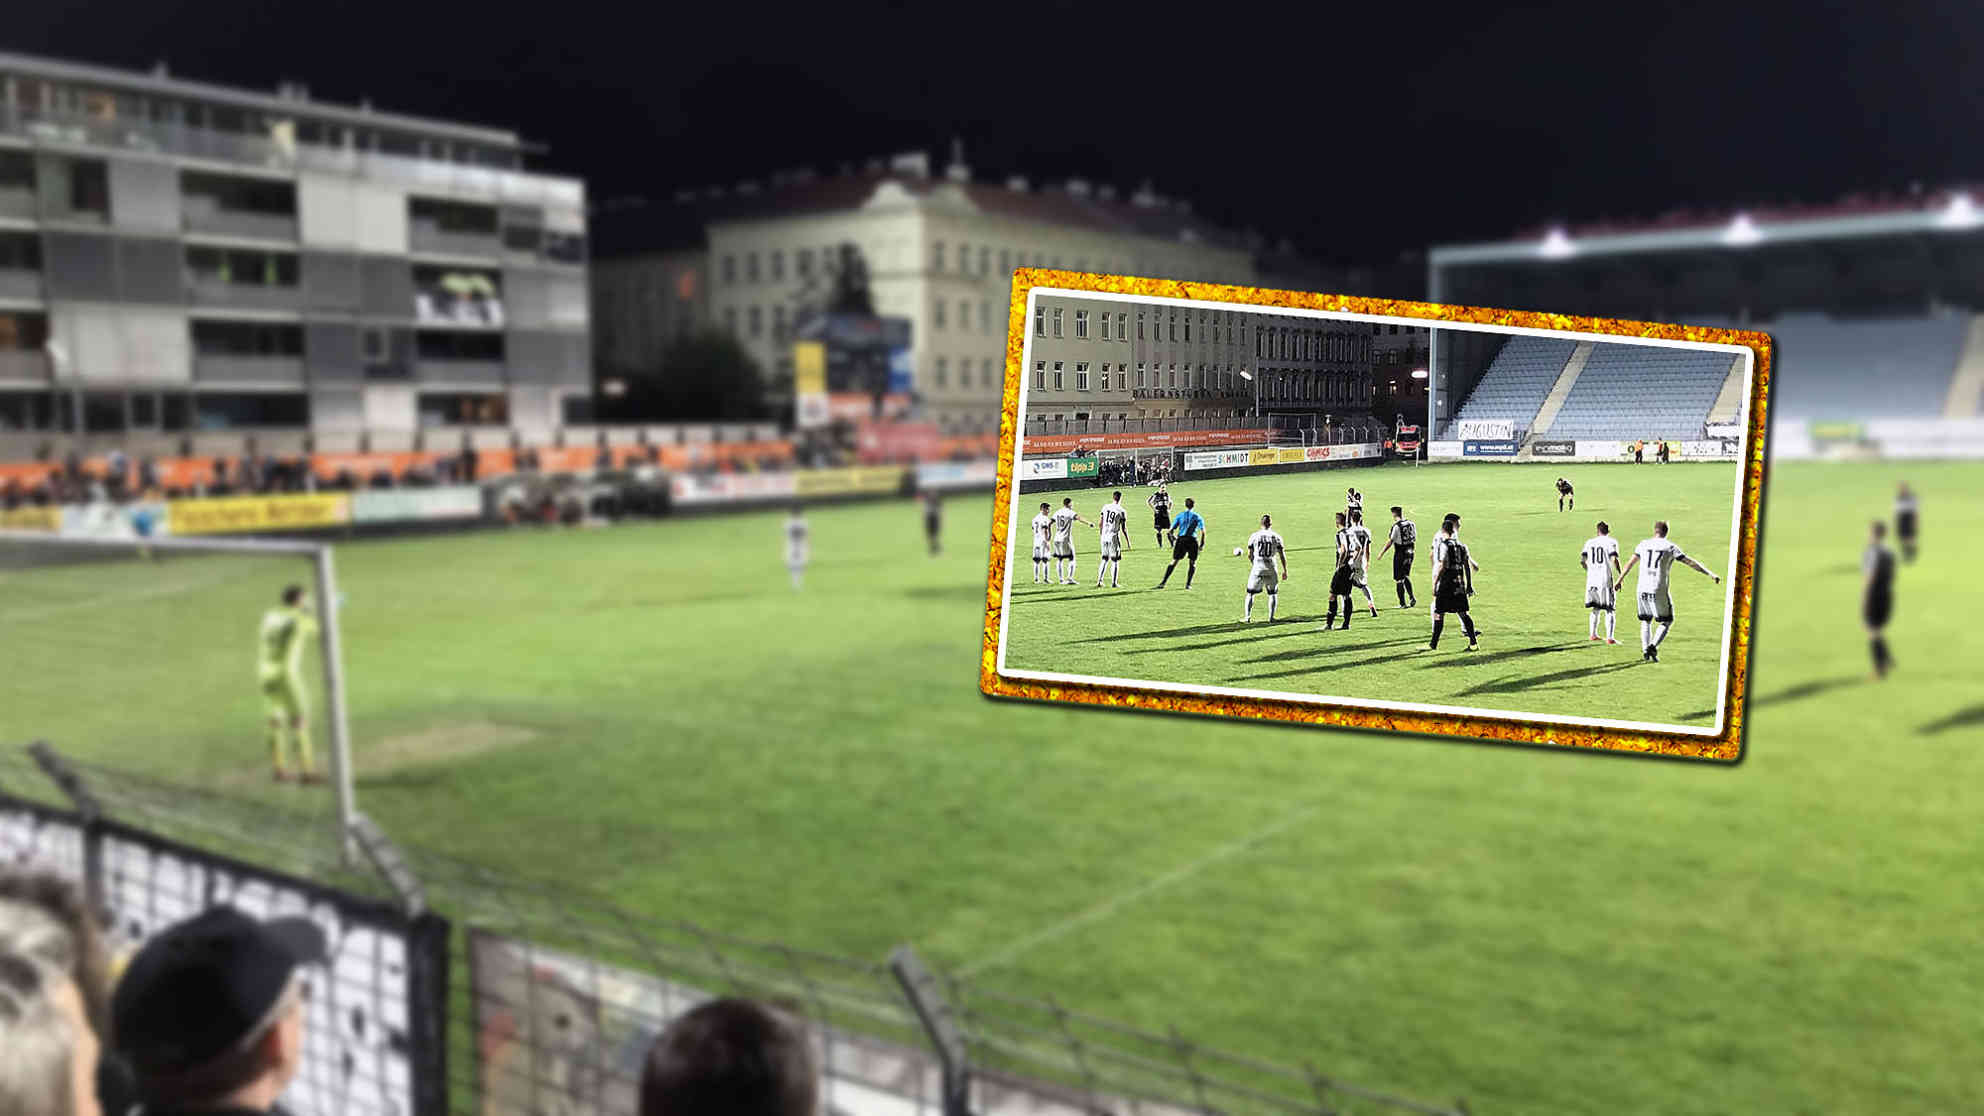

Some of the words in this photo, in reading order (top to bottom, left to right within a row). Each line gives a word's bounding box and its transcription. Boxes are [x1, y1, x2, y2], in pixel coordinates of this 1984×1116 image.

[1056, 514, 1066, 527] 16
[1106, 510, 1116, 525] 19
[1257, 541, 1272, 558] 20
[1591, 546, 1604, 564] 10
[1647, 549, 1664, 569] 17
